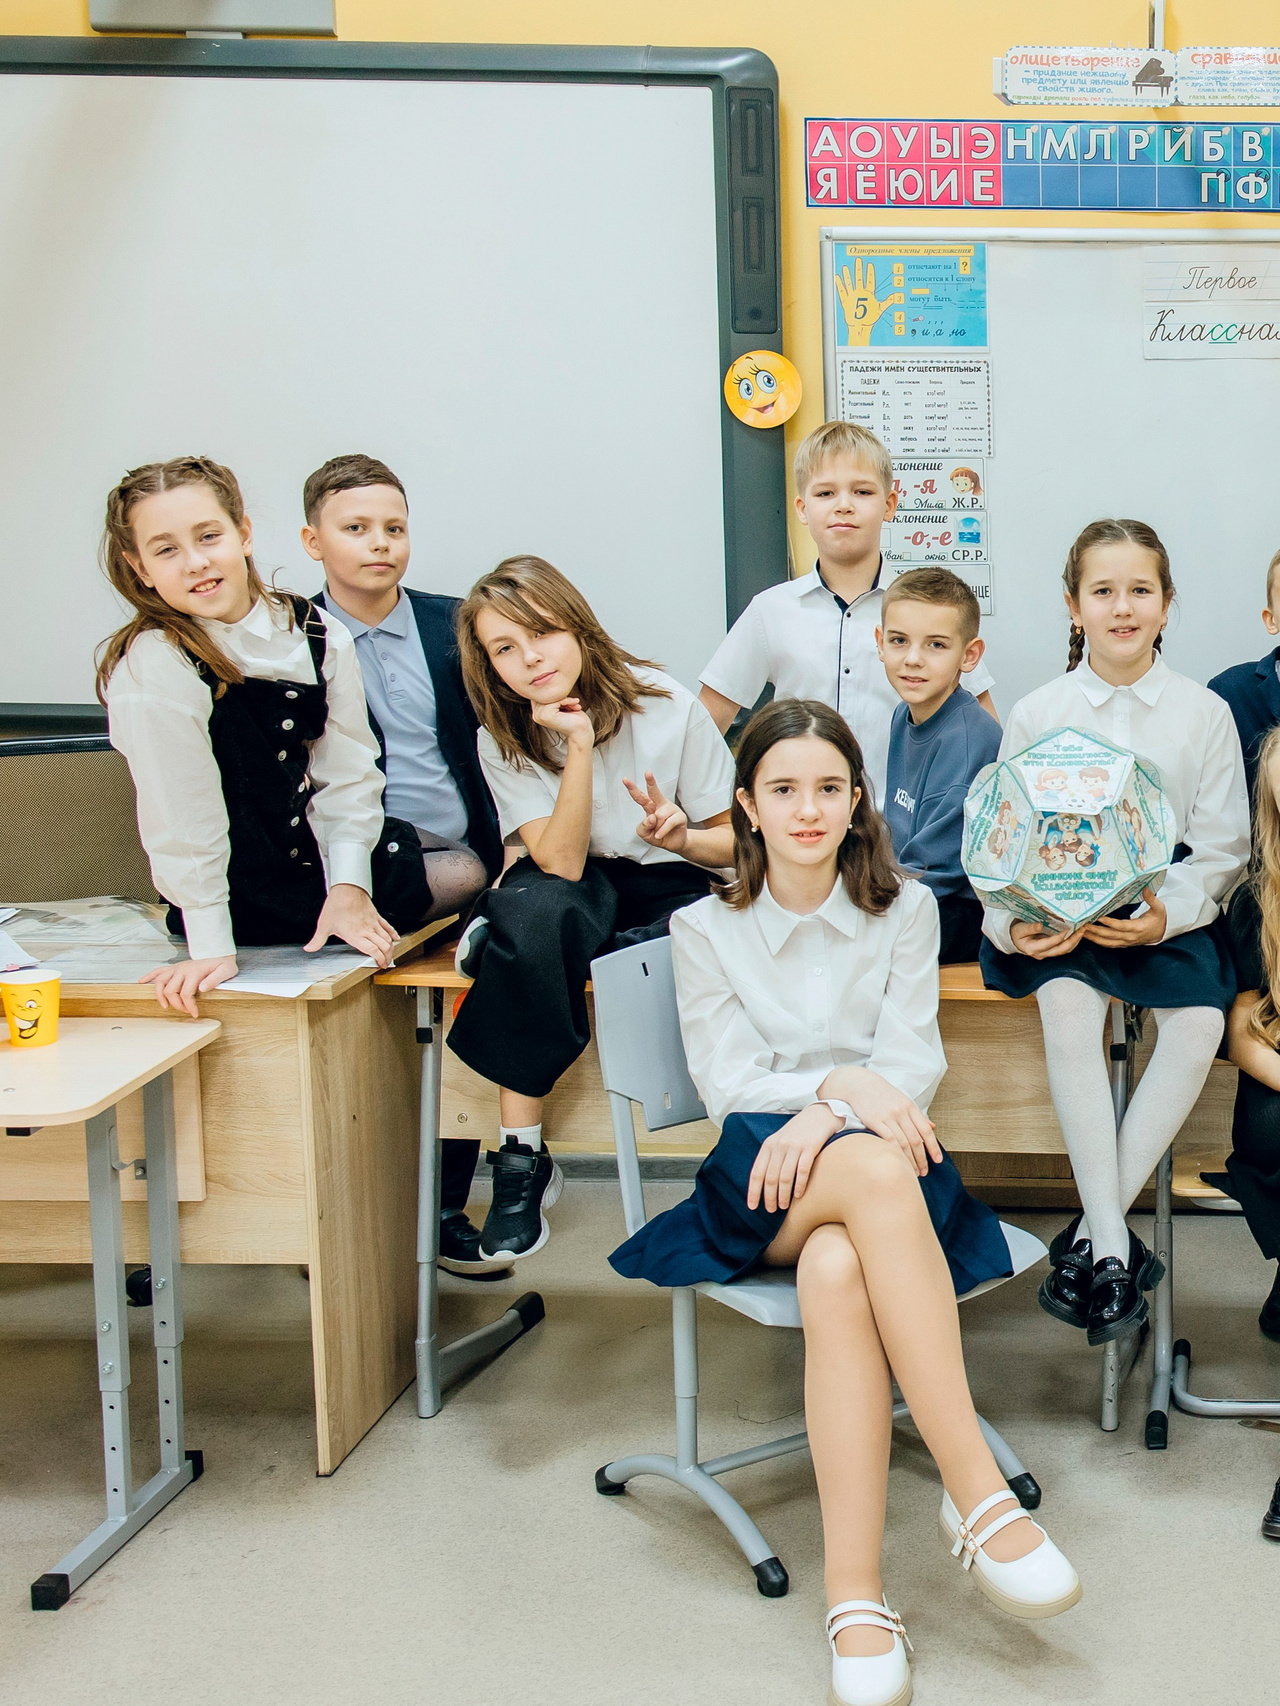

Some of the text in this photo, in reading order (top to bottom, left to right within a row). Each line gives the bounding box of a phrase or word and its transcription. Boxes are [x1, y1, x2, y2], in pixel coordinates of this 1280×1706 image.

[1010, 54, 1140, 70] олицетворение
[1033, 69, 1127, 79] придание неживому
[1022, 78, 1066, 87] предмету
[811, 126, 843, 158] А
[849, 126, 883, 159] О
[890, 126, 919, 158] У
[929, 127, 960, 159] Ы
[971, 127, 996, 159] Э
[1006, 128, 1032, 160] Н
[1041, 128, 1077, 160] М
[1083, 129, 1110, 160] Л
[1128, 130, 1150, 161] Р
[1164, 126, 1192, 162] Й
[1202, 131, 1225, 162] Б
[1242, 132, 1263, 163] В
[815, 168, 837, 199] Я
[856, 164, 877, 200] Ё
[889, 168, 924, 202] Ю
[930, 168, 957, 201] И
[973, 169, 995, 202] Е
[1201, 172, 1227, 203] П
[1235, 171, 1269, 204] Ф
[1183, 266, 1257, 298] Первое
[854, 298, 868, 320] 5
[914, 498, 982, 509] Мила Ж.Р.
[952, 550, 987, 561] СР.Р.
[1054, 744, 1083, 752] Тебе
[1085, 870, 1118, 881] День
[1034, 881, 1114, 891] празднуется
[1055, 891, 1094, 902] Когда
